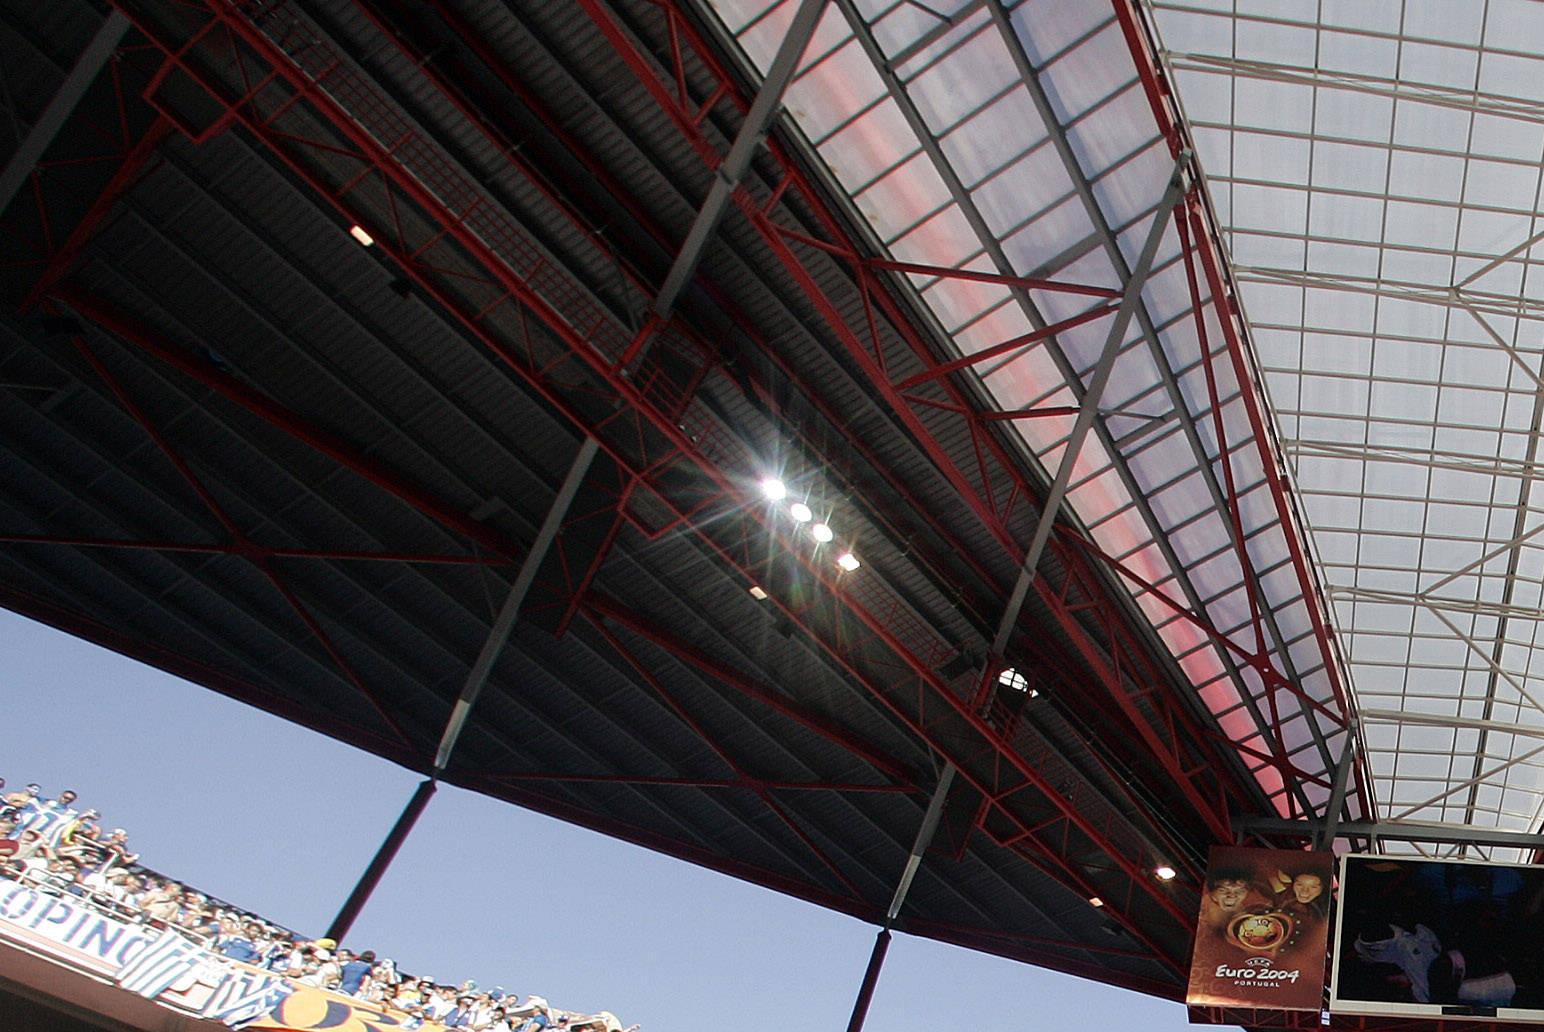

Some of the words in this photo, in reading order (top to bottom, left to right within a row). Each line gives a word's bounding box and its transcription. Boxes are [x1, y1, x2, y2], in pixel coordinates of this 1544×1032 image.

[1215, 964, 1256, 978] Euro
[1257, 968, 1299, 983] 2004
[1234, 980, 1280, 988] PORTUGAL
